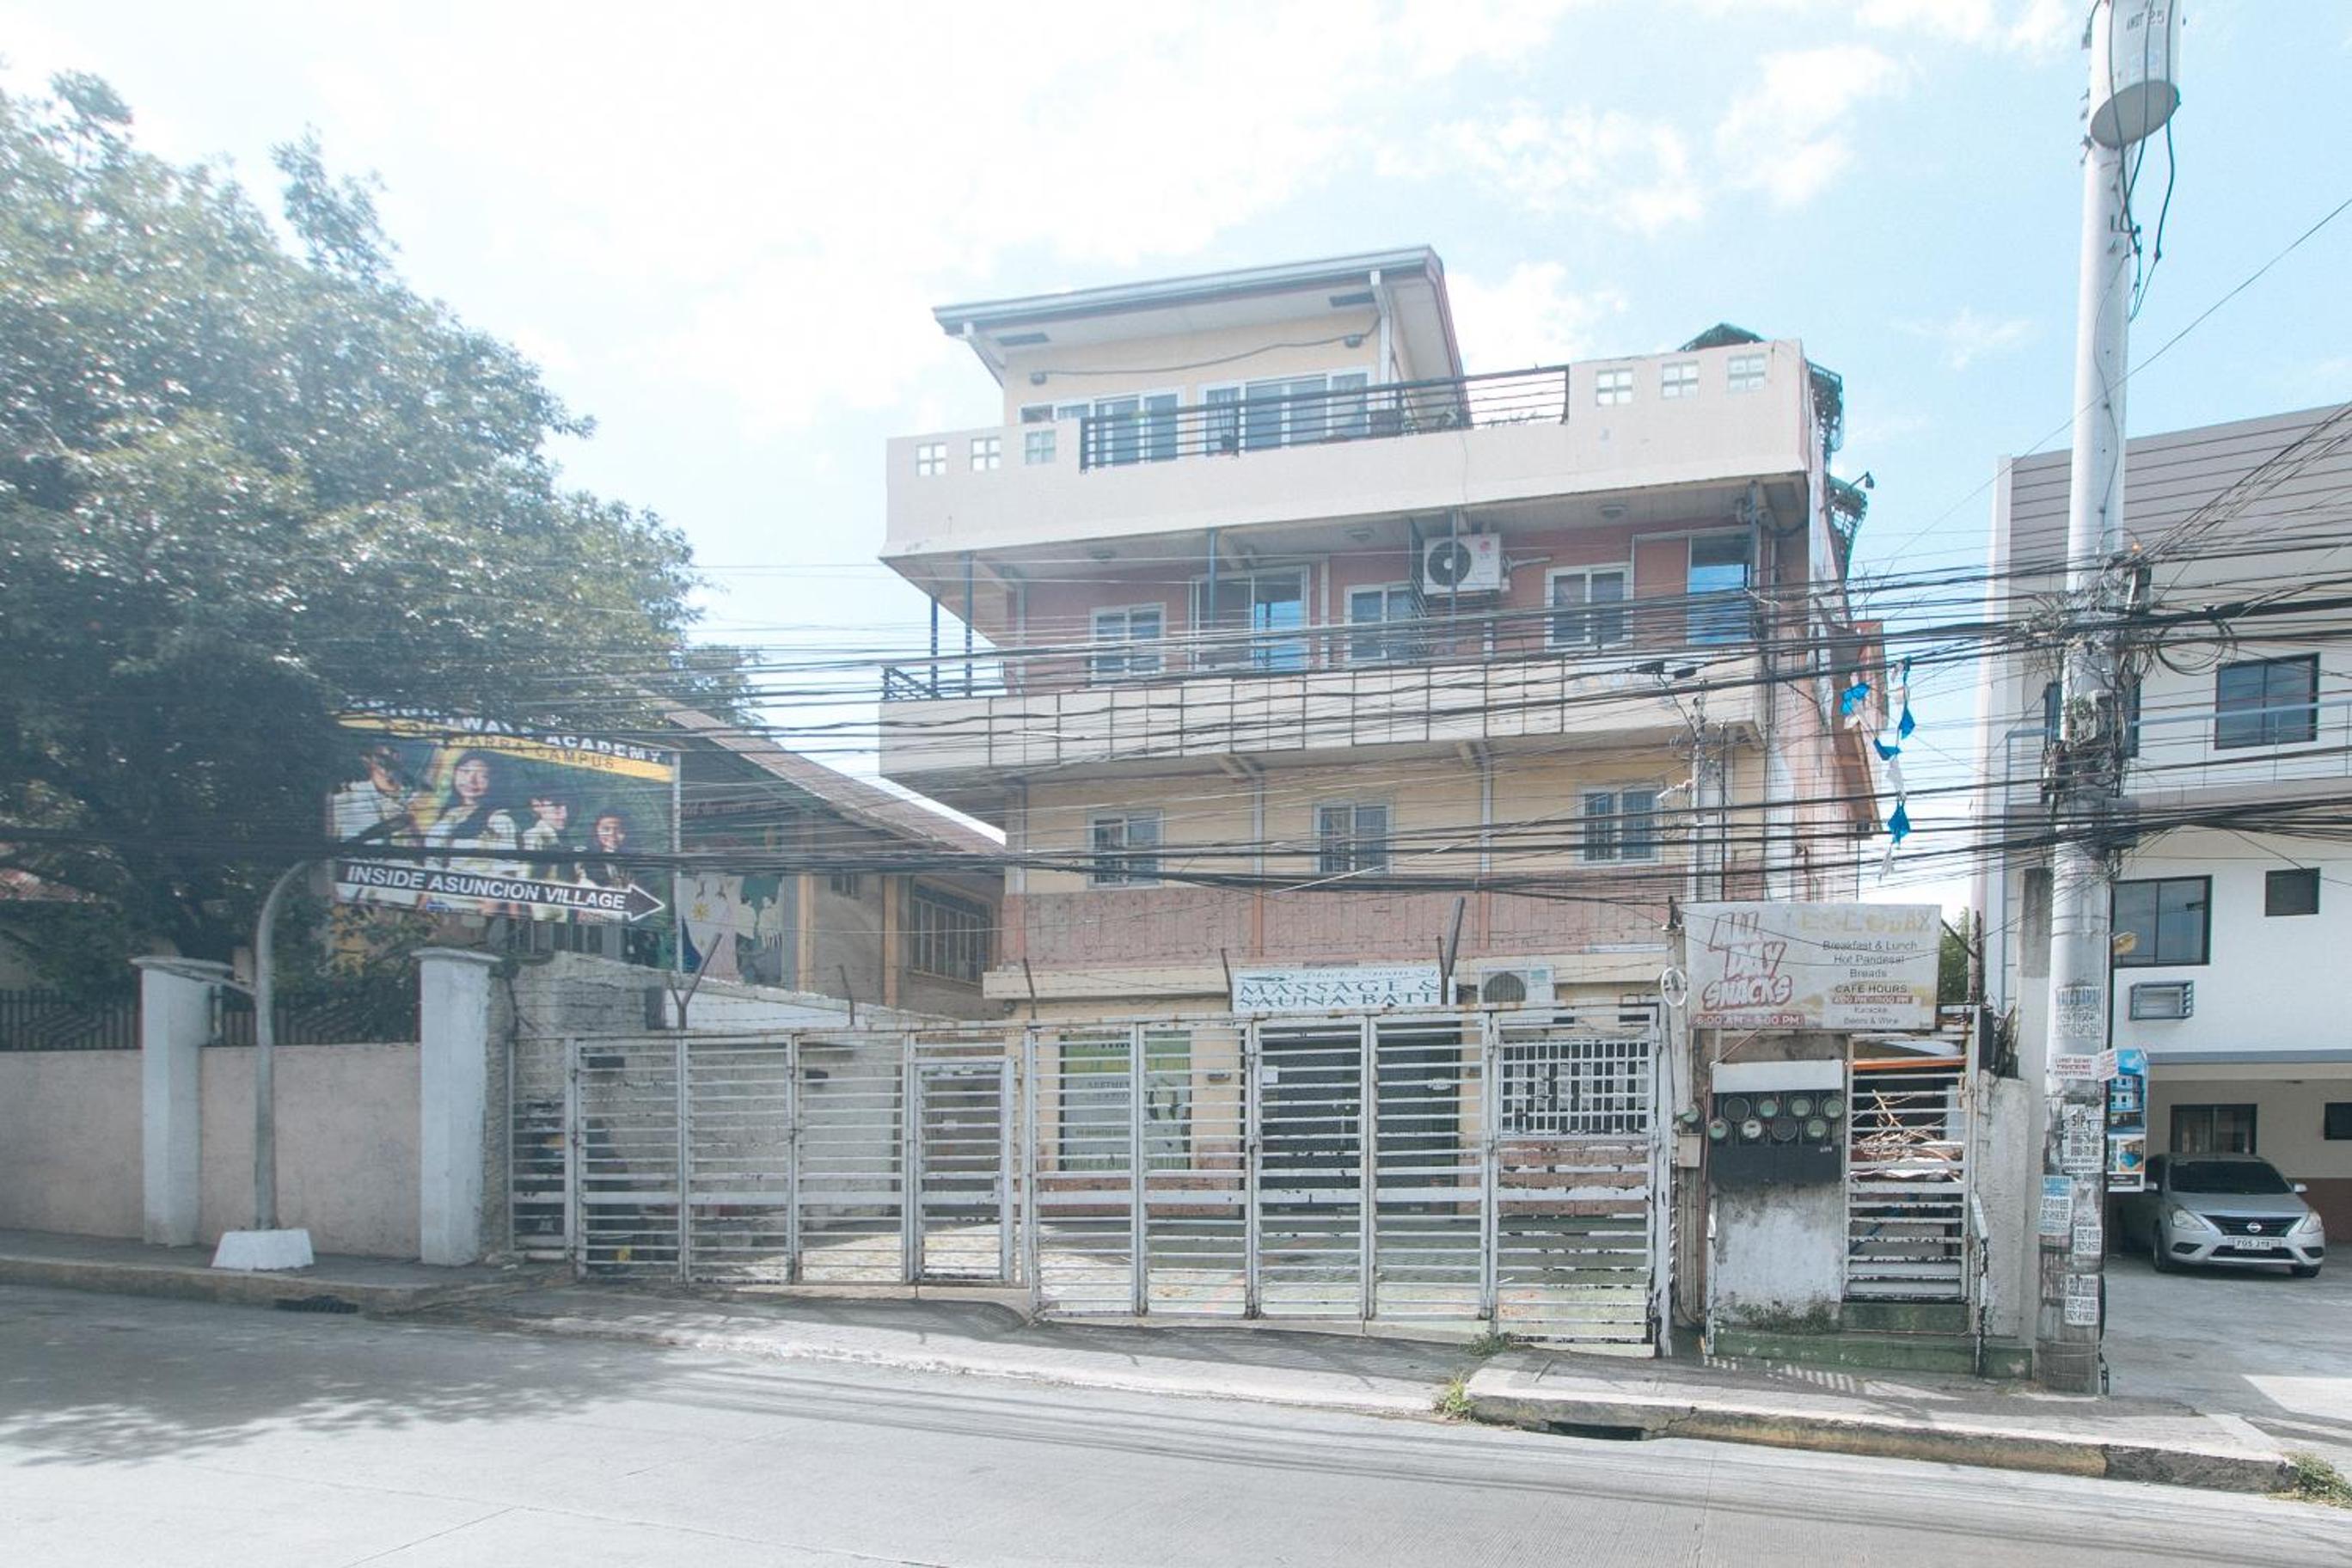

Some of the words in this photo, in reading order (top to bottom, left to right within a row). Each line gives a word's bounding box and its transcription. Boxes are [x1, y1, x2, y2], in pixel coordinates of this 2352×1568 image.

[546, 735, 663, 764] ACADEMY
[535, 748, 615, 769] CAMPUS
[346, 866, 425, 890] INSIDE
[428, 873, 541, 902] ASUNCION
[545, 887, 626, 910] VILLAGE
[1822, 940, 1872, 951] Breakfast
[1886, 940, 1918, 951] Lunch
[1855, 954, 1906, 965] Pandesal
[1849, 968, 1888, 978] Breads
[1239, 980, 1401, 996] MASSAGE
[1418, 979, 1440, 990] &
[1703, 976, 1792, 1010] SNACKS
[1868, 983, 1908, 994] HOURS
[1240, 993, 1348, 1007] SAUNA
[1782, 1015, 1800, 1025] PM
